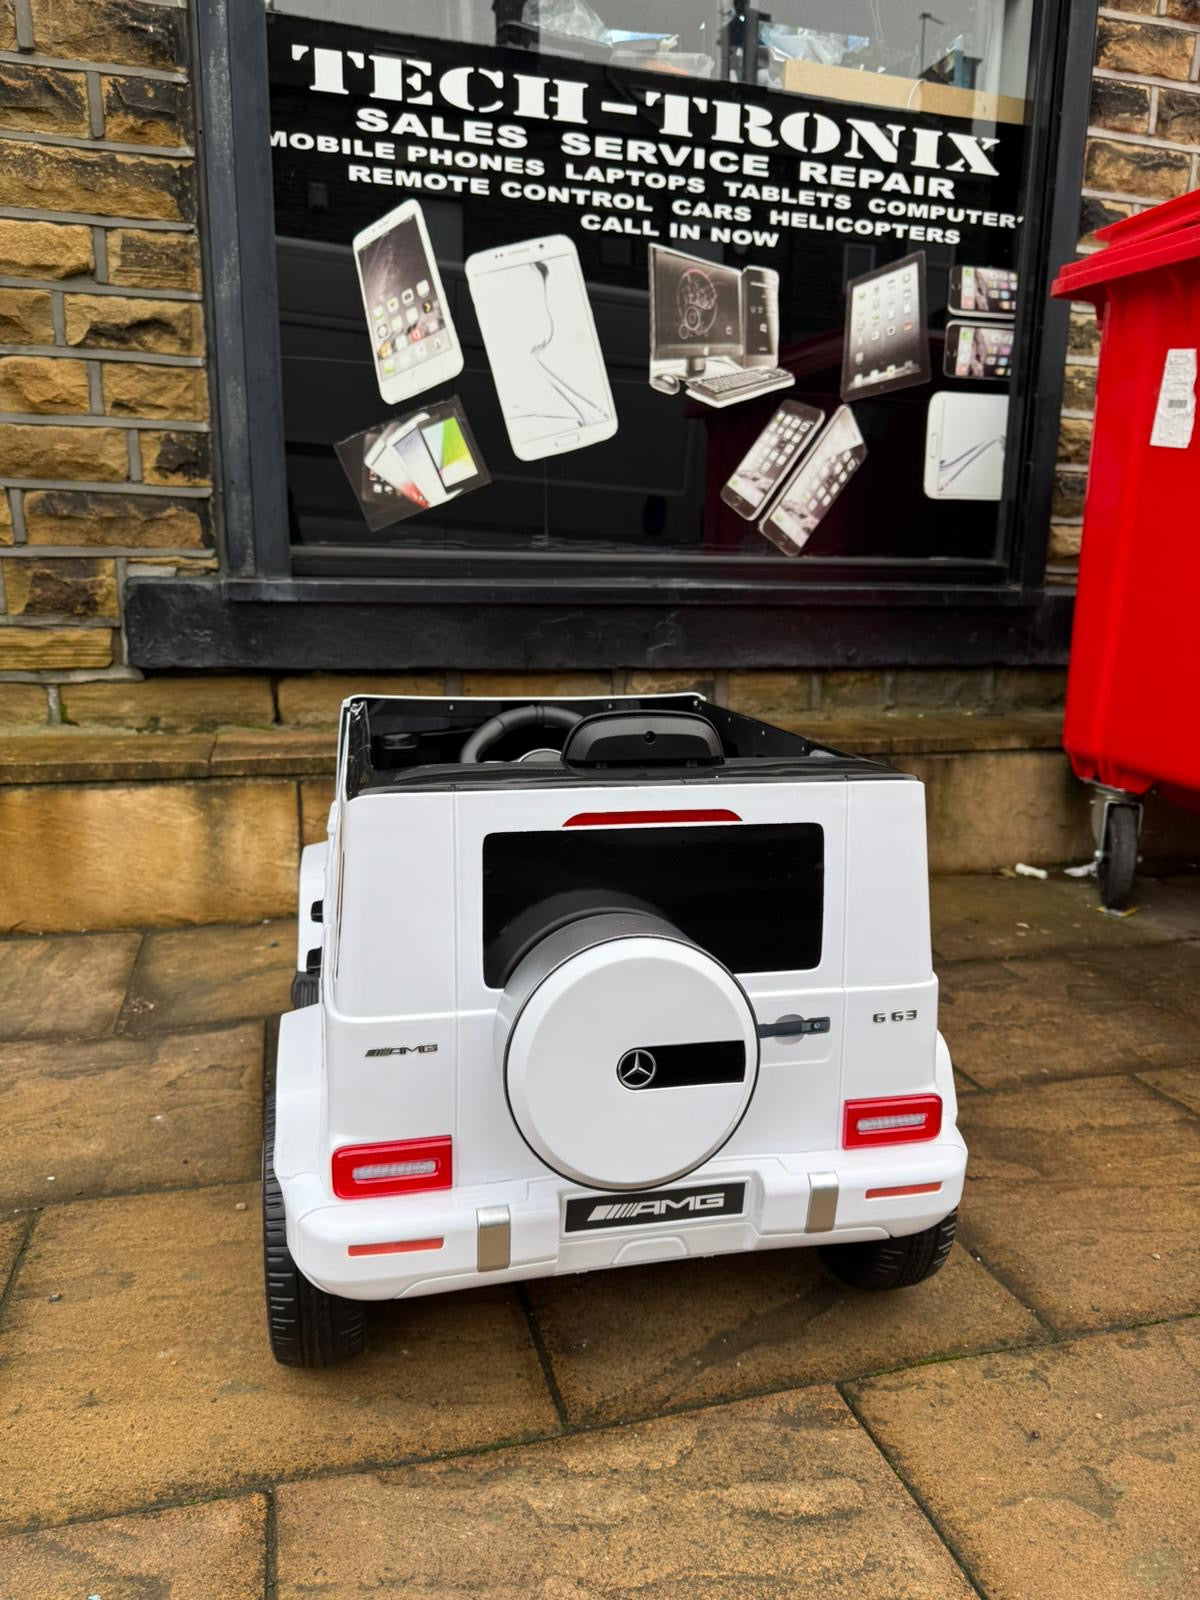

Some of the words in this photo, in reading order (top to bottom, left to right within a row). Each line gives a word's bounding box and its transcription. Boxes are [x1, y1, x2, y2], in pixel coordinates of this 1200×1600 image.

[291, 44, 1000, 178] TECH-TRONIX
[355, 107, 528, 149] SALES
[560, 132, 770, 178] SERVICE
[800, 160, 956, 200] REPAIR
[407, 145, 545, 177] PHONES
[565, 163, 706, 194] LAPTOPS
[723, 180, 852, 211] TABLETS
[867, 197, 1024, 230] COMPUTER
[348, 164, 490, 196] REMOTE
[500, 181, 654, 213] CONTROL
[671, 199, 753, 222] CARS
[769, 209, 961, 245] HELICOPTERS
[580, 213, 660, 237] CALL
[669, 222, 700, 240] IN
[710, 228, 780, 249] NOW
[873, 1011, 886, 1024] G
[891, 1009, 918, 1023] 63
